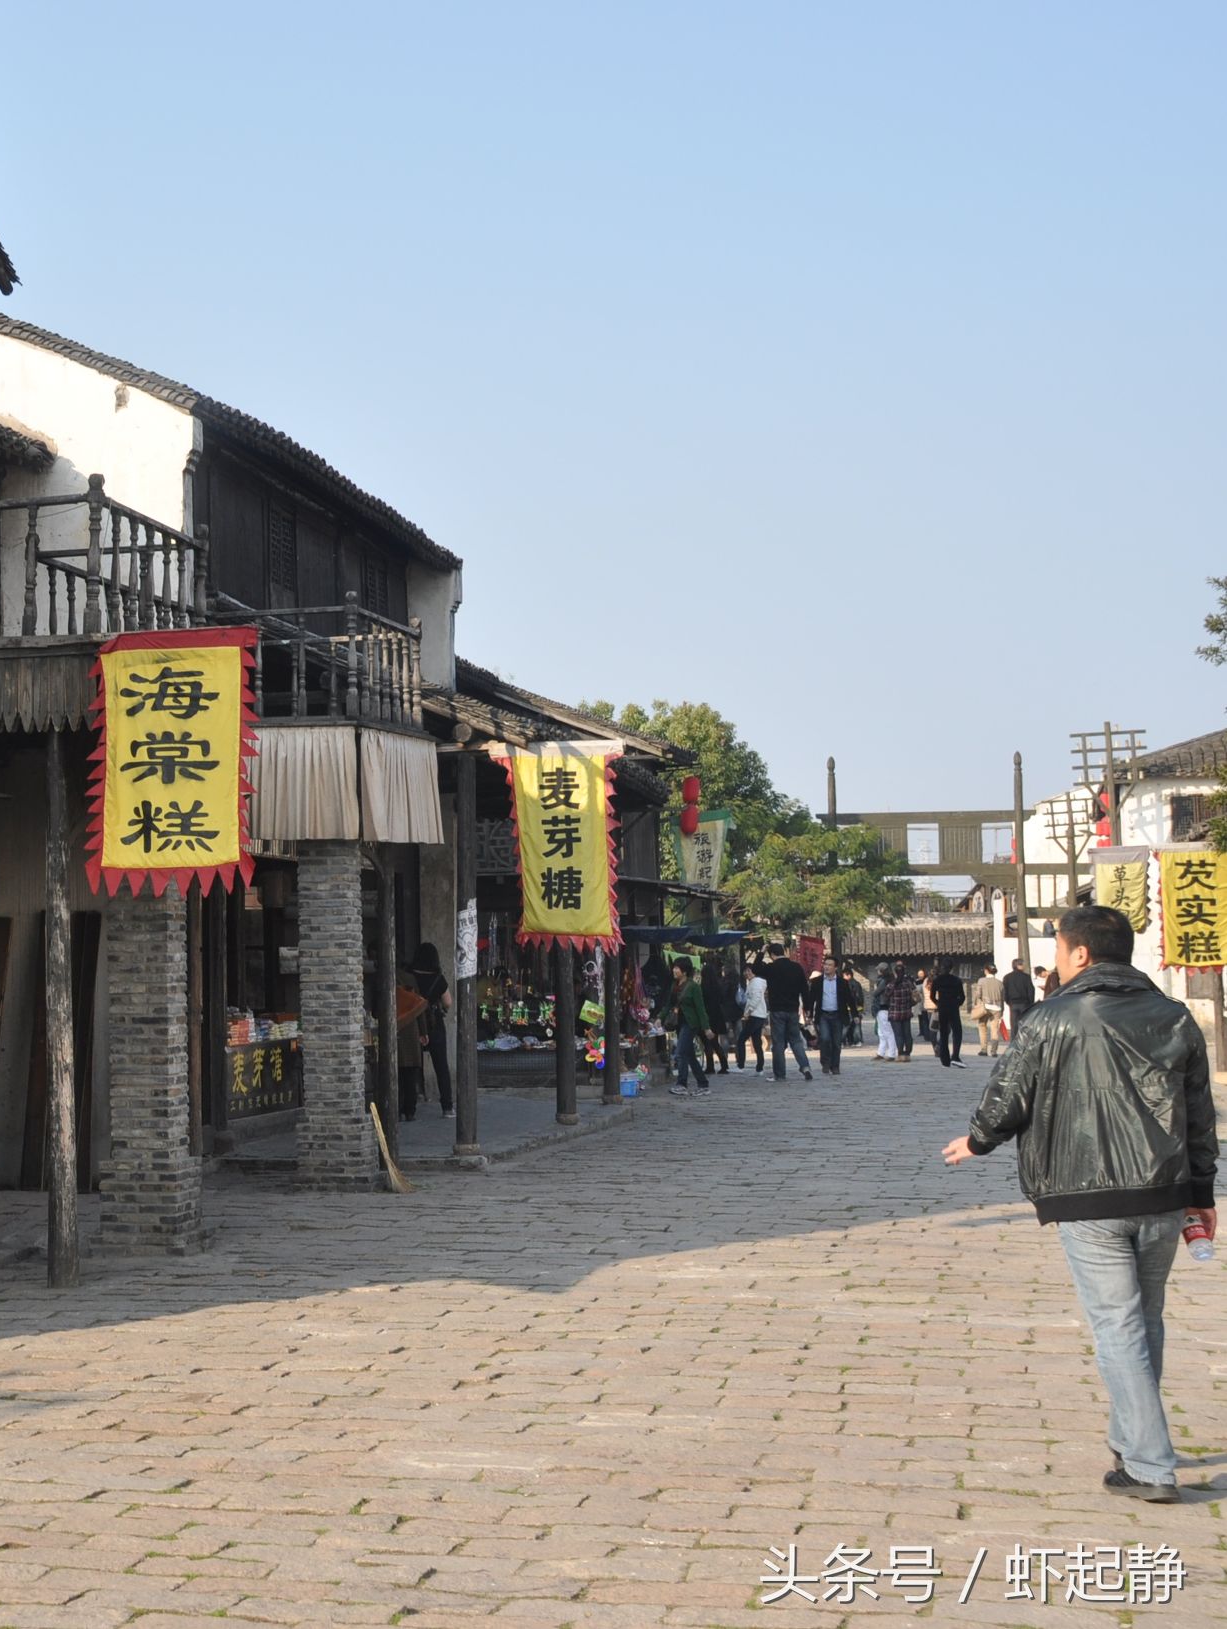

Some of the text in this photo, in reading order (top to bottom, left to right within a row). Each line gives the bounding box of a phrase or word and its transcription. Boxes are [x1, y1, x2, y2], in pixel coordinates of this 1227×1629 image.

[119, 666, 220, 853] 海棠糕
[538, 767, 584, 911] 麦芽糖
[1175, 860, 1222, 963] 芡实糕
